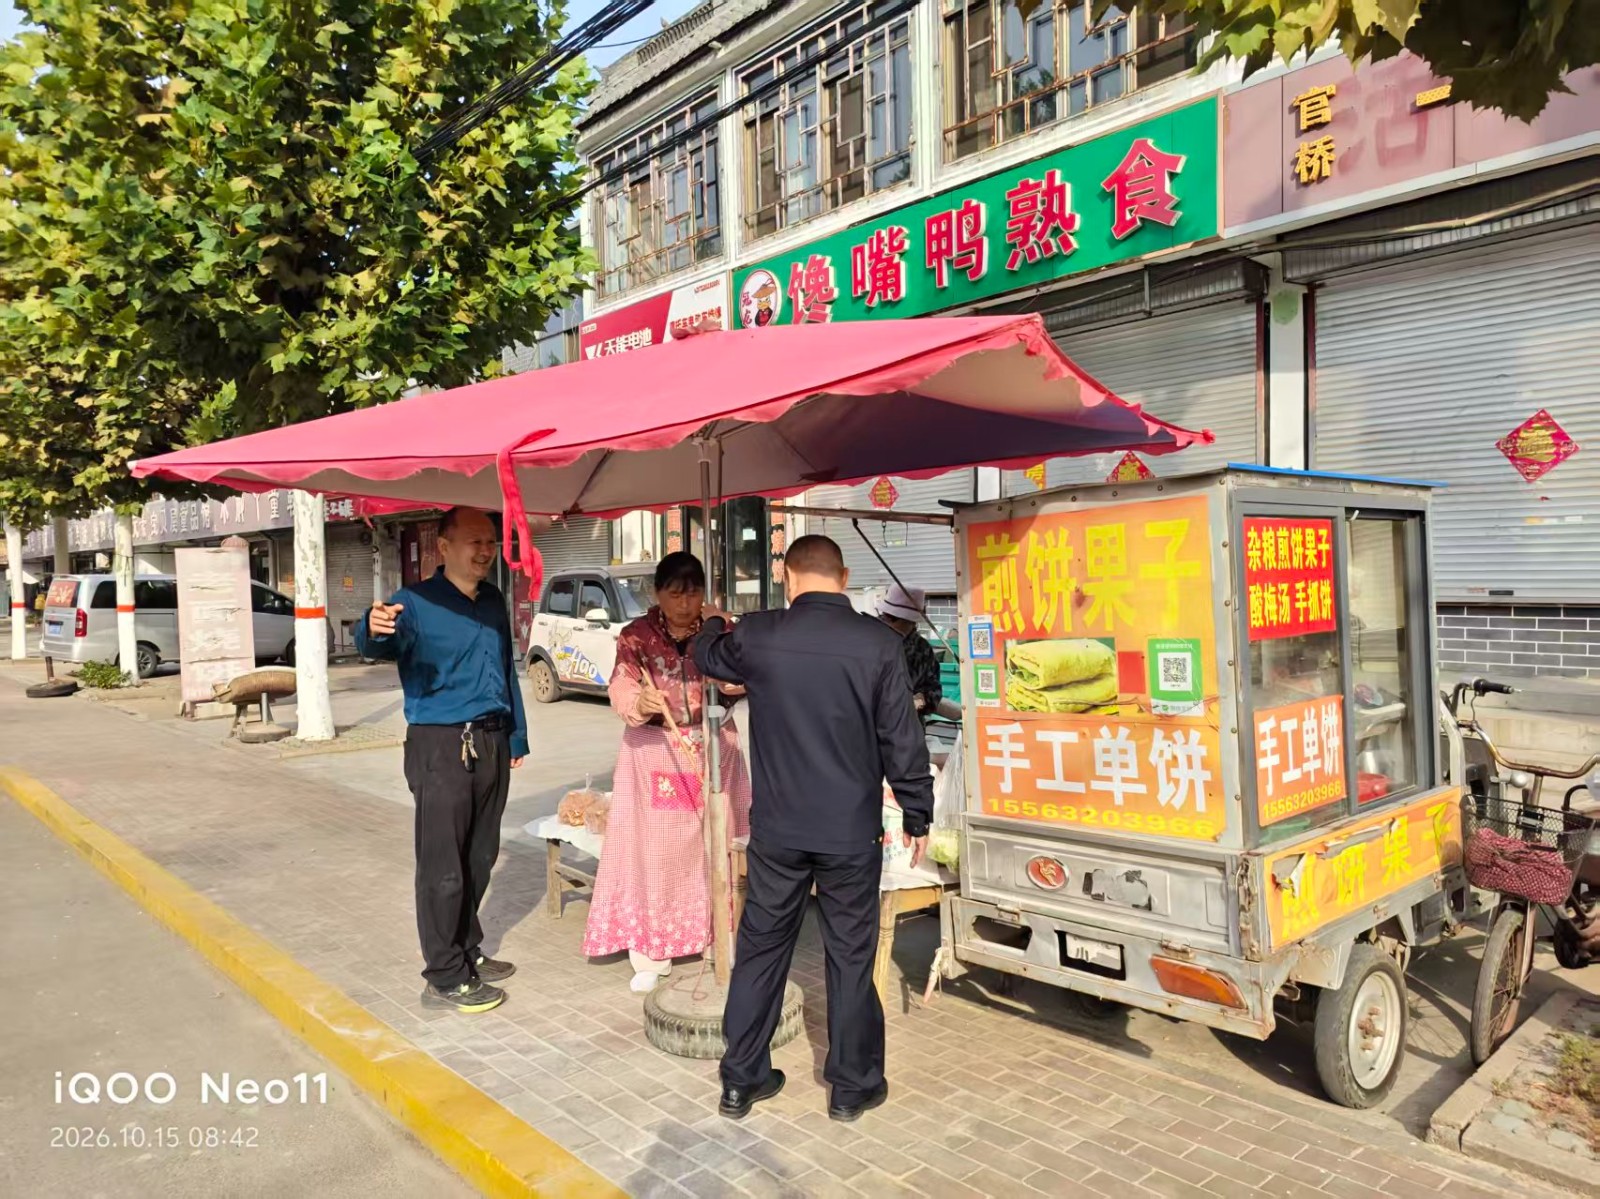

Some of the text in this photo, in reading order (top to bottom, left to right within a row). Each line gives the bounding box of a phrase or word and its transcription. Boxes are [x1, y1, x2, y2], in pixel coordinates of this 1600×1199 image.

[1293, 84, 1337, 184] 官桥
[787, 137, 1186, 324] 馋嘴鸭熟食
[603, 327, 653, 356] 天能电池
[976, 518, 1201, 634] 煎饼果子
[1247, 526, 1331, 573] 杂粮煎饼果子
[1249, 578, 1333, 629] 酸梅汤 手抓饼
[984, 721, 1212, 813] 手工单饼
[1258, 702, 1341, 797] 手工单饼
[988, 798, 1216, 837] 15563203966
[1263, 781, 1342, 820] 15563203966
